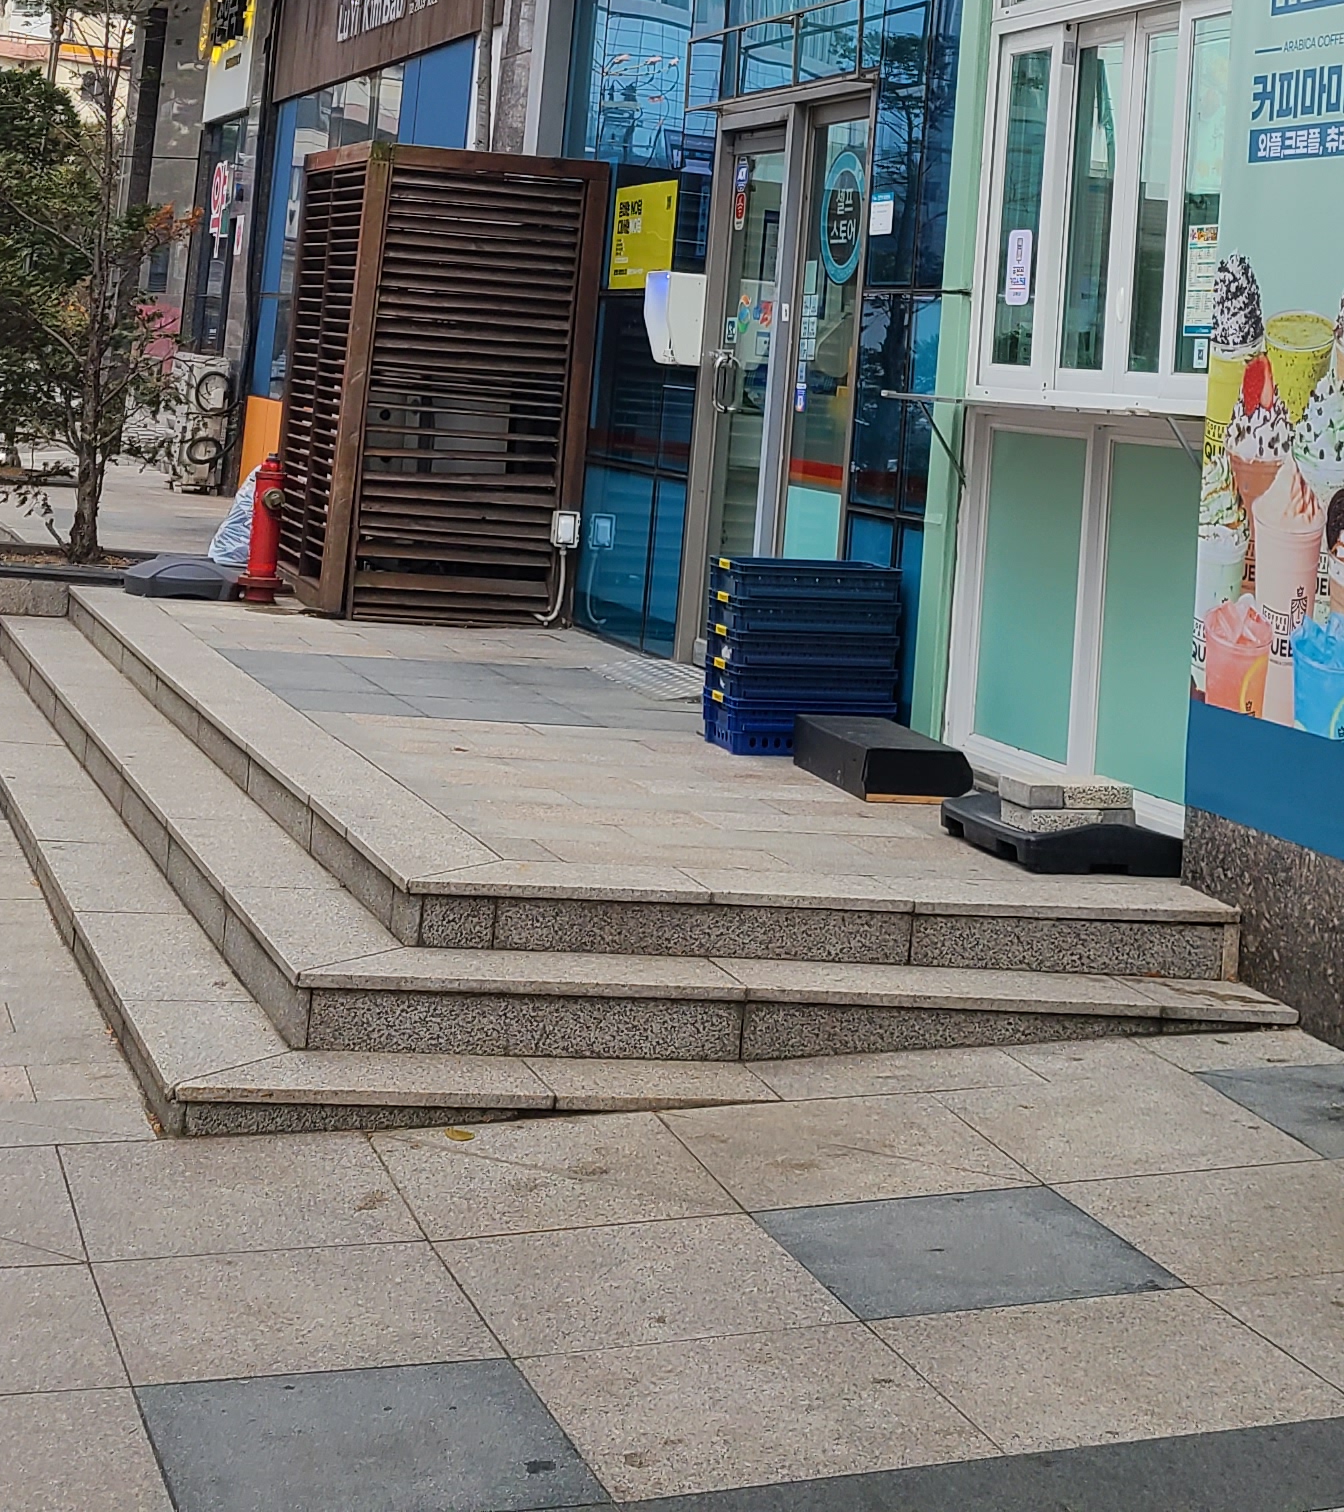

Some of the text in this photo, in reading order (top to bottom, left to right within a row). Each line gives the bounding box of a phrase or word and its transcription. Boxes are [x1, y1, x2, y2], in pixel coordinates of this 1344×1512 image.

[1283, 37, 1316, 53] ARABICA
[835, 188, 854, 215] 셀프
[829, 219, 857, 245] 스토어
